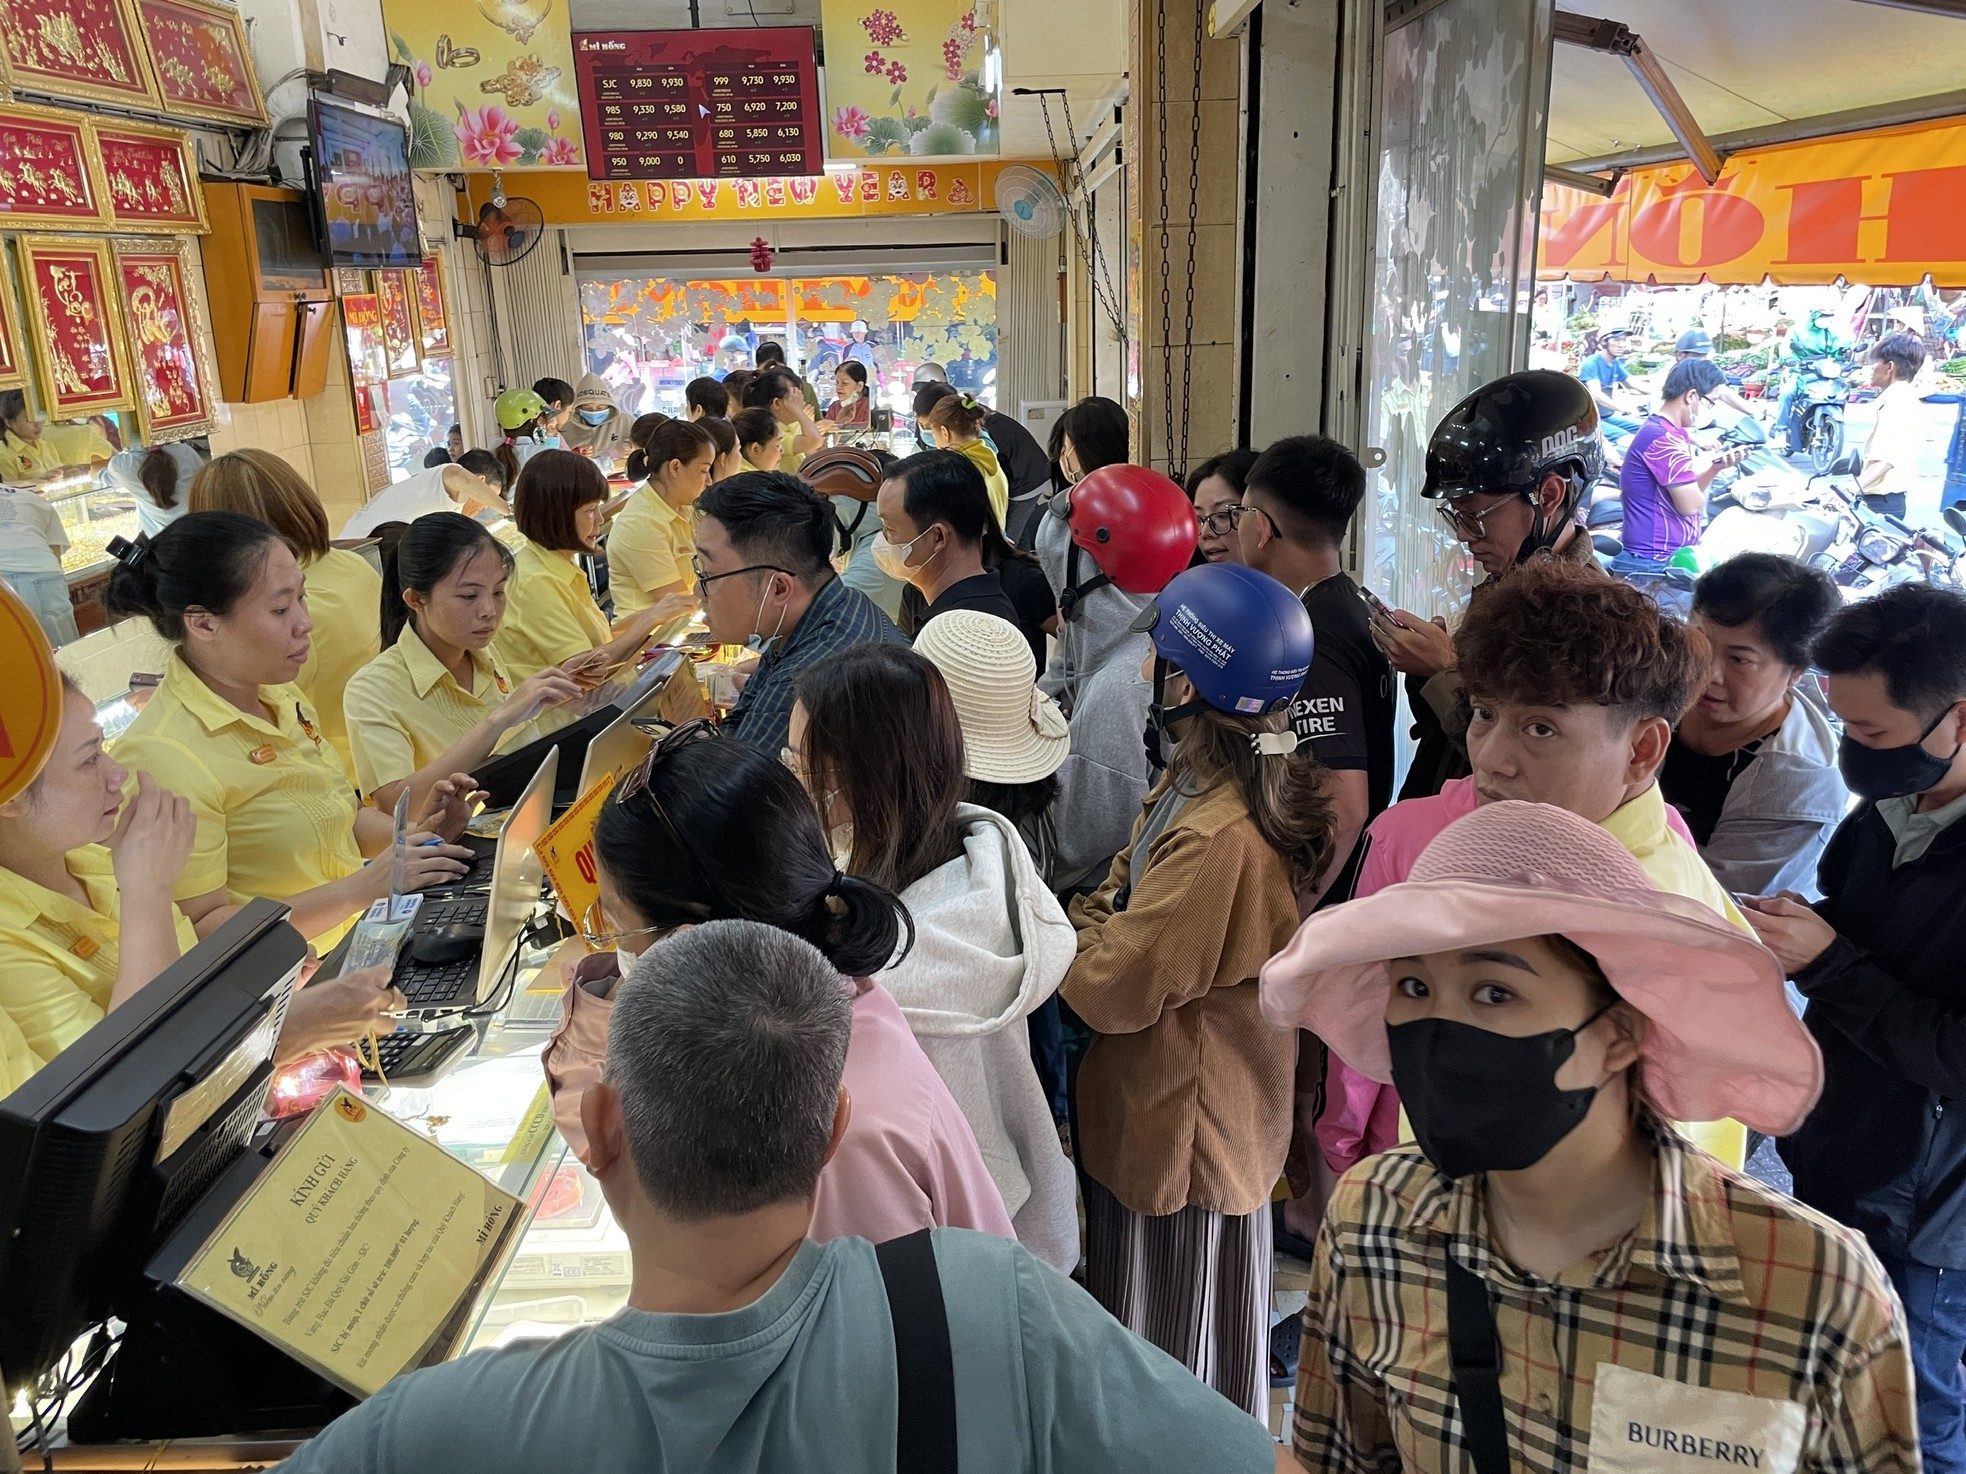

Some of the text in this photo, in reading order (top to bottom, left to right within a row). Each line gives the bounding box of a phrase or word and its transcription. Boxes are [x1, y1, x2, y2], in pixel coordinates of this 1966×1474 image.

[603, 77, 684, 89] SJC 9,830 9,930
[713, 75, 796, 86] 999 9,730 9,930
[605, 104, 686, 115] 985 9,330 9,580
[716, 101, 798, 113] 750 6,920 7,200
[608, 130, 689, 141] 980 9,290 9,540
[718, 127, 800, 139] 680 5,850 6,130
[611, 156, 684, 167] 950 9,000 0
[721, 153, 801, 164] 610 5,750 6,030
[587, 170, 939, 213] HAPPY NEW YEAR
[1175, 610, 1232, 660] THỊNH VƯỢNG PHÁT
[1216, 637, 1224, 645] XE
[1223, 642, 1236, 654] MÁY
[1288, 697, 1345, 720] NEXEN
[1296, 717, 1336, 735] TIRE
[290, 1154, 335, 1206] KÍNH GỬI
[305, 1157, 357, 1223] QUÝ KHÁCH HÀNG
[330, 1338, 343, 1353] SJC
[339, 1329, 350, 1339] bị
[1628, 1421, 1765, 1469] BURBERRY
